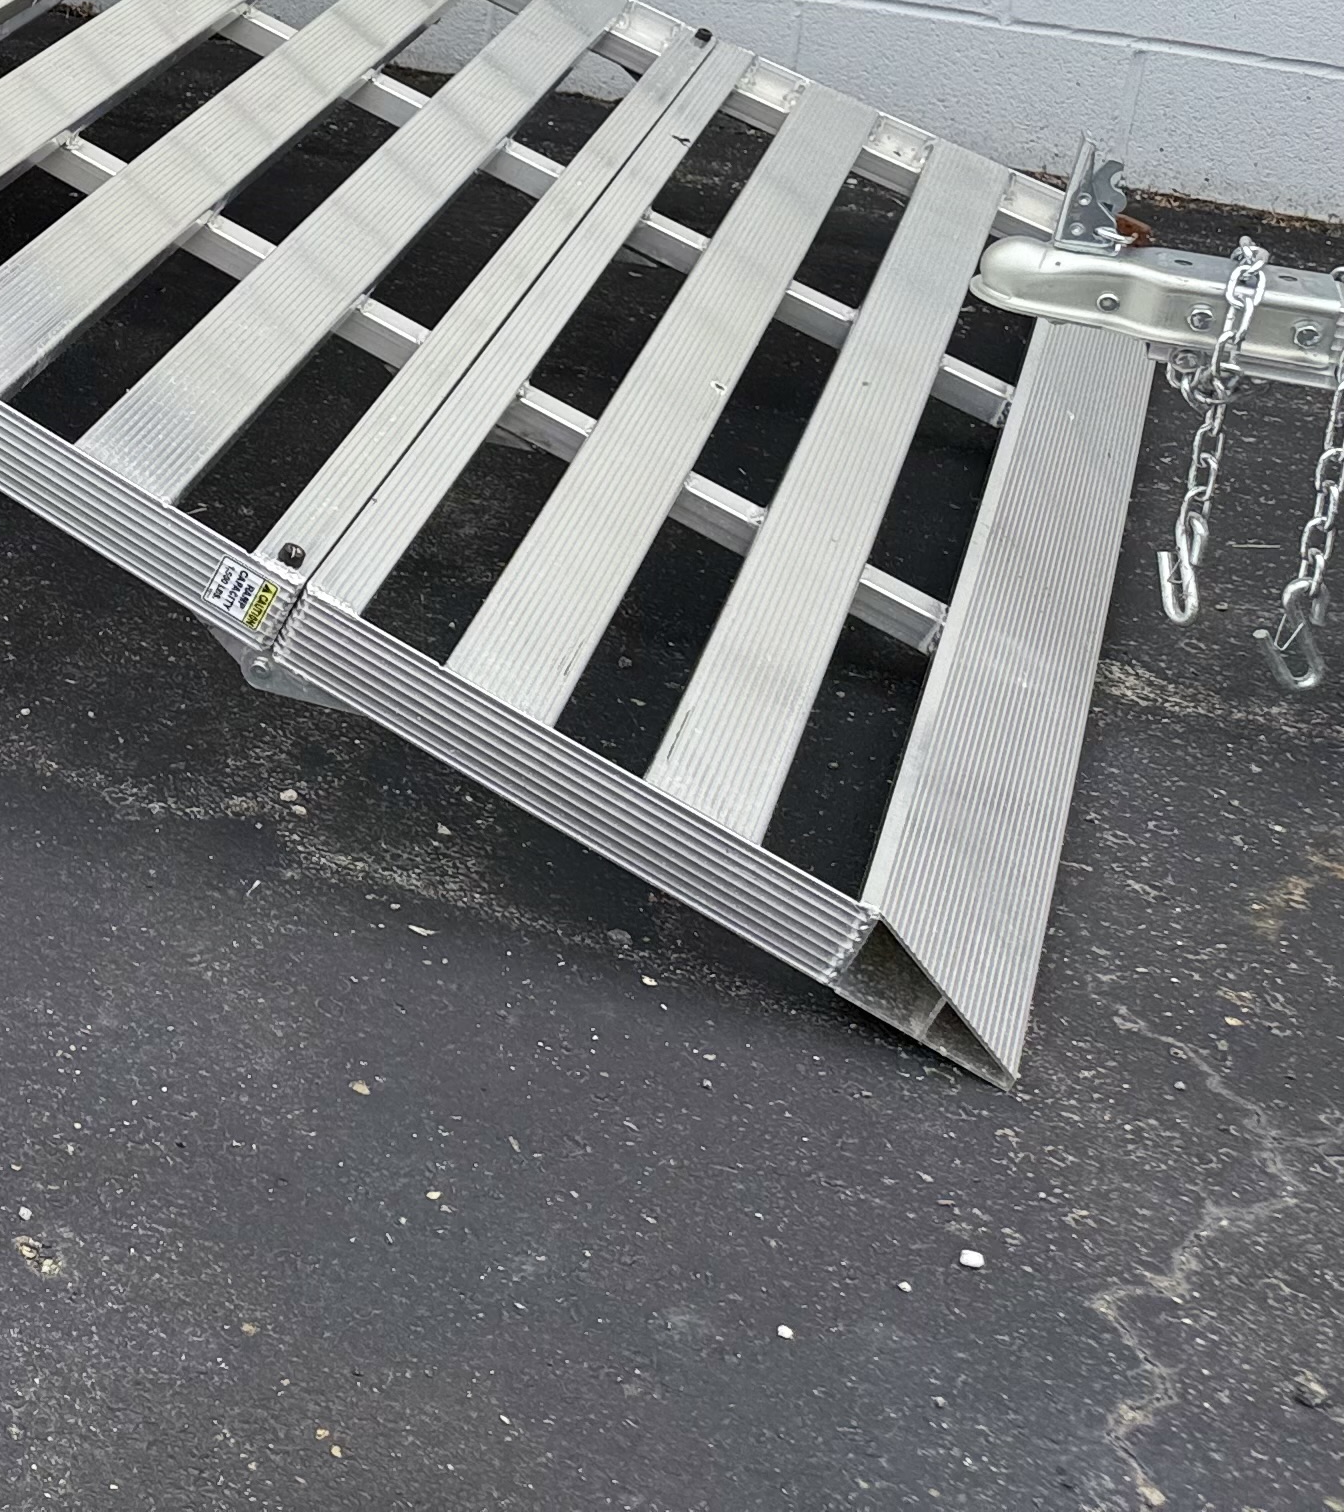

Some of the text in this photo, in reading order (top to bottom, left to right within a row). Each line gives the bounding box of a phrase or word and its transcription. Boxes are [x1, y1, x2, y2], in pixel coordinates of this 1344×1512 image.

[223, 570, 248, 611] CAPACITY
[238, 585, 255, 609] RAMP
[246, 594, 269, 627] CAUTION
